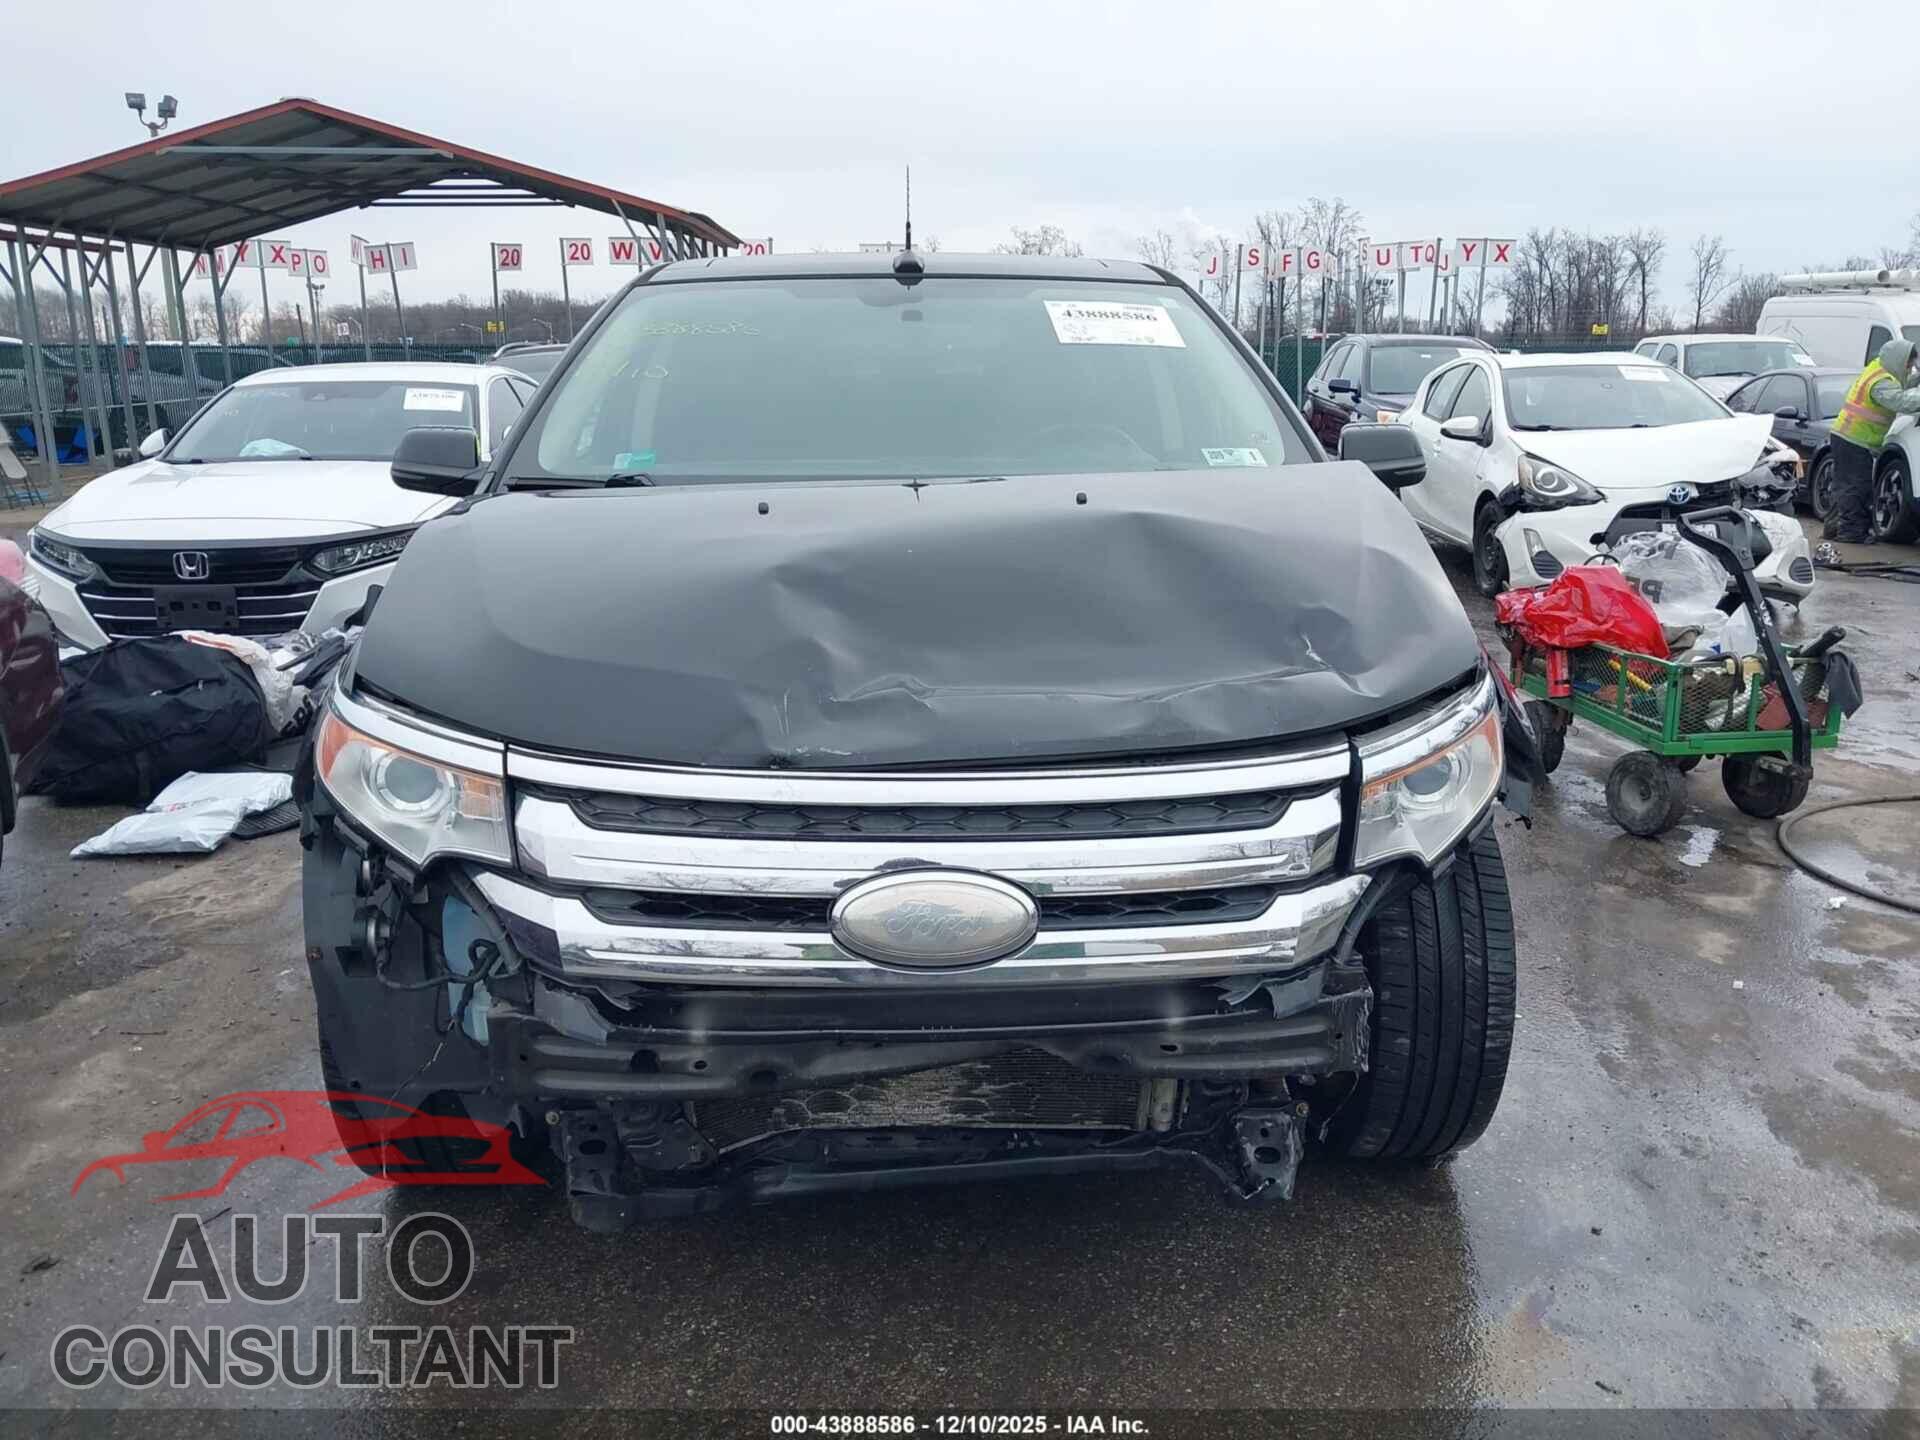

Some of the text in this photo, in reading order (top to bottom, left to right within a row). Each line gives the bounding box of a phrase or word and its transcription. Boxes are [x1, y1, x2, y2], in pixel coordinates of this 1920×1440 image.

[234, 243, 287, 264] Y X
[371, 250, 384, 269] H
[500, 248, 520, 267] 20
[569, 242, 591, 261] 20
[611, 241, 633, 260] W
[1248, 248, 1259, 266] S
[1376, 246, 1423, 266] U T
[1425, 244, 1435, 263] Q
[1462, 243, 1509, 262] Y X
[291, 253, 301, 271] P
[1207, 256, 1217, 274] J
[1283, 253, 1292, 272] F
[1307, 251, 1320, 269] G
[1440, 254, 1448, 271] J
[1062, 309, 1159, 321] 43888586
